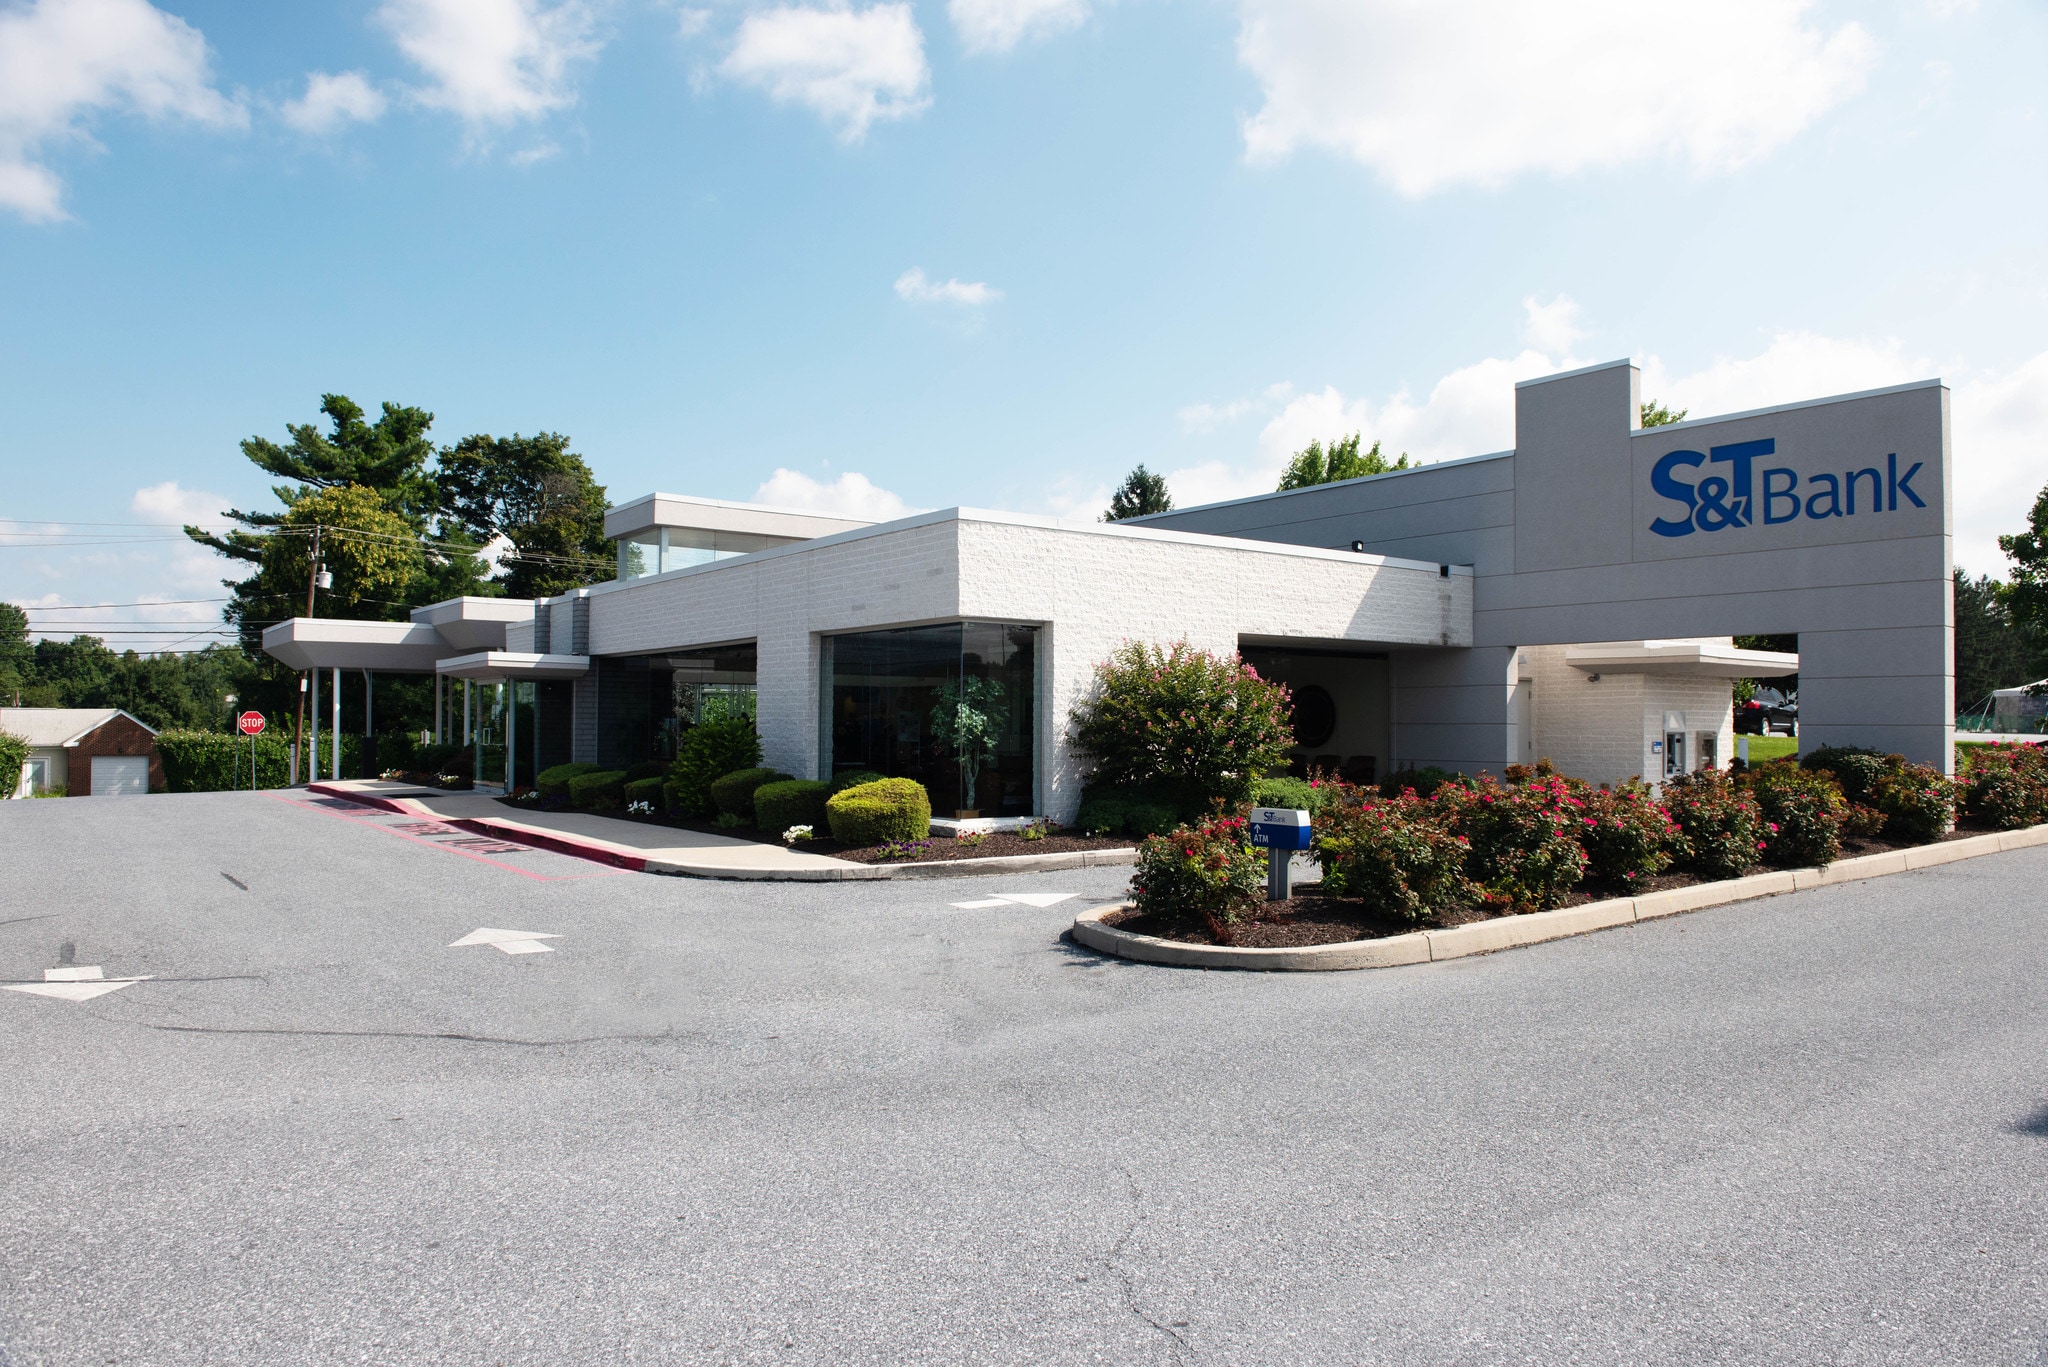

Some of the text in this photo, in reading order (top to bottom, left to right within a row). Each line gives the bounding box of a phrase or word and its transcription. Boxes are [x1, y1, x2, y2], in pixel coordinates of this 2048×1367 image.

[1649, 438, 1927, 537] S&T Bank
[241, 718, 264, 728] STOP
[1253, 834, 1269, 843] ATM
